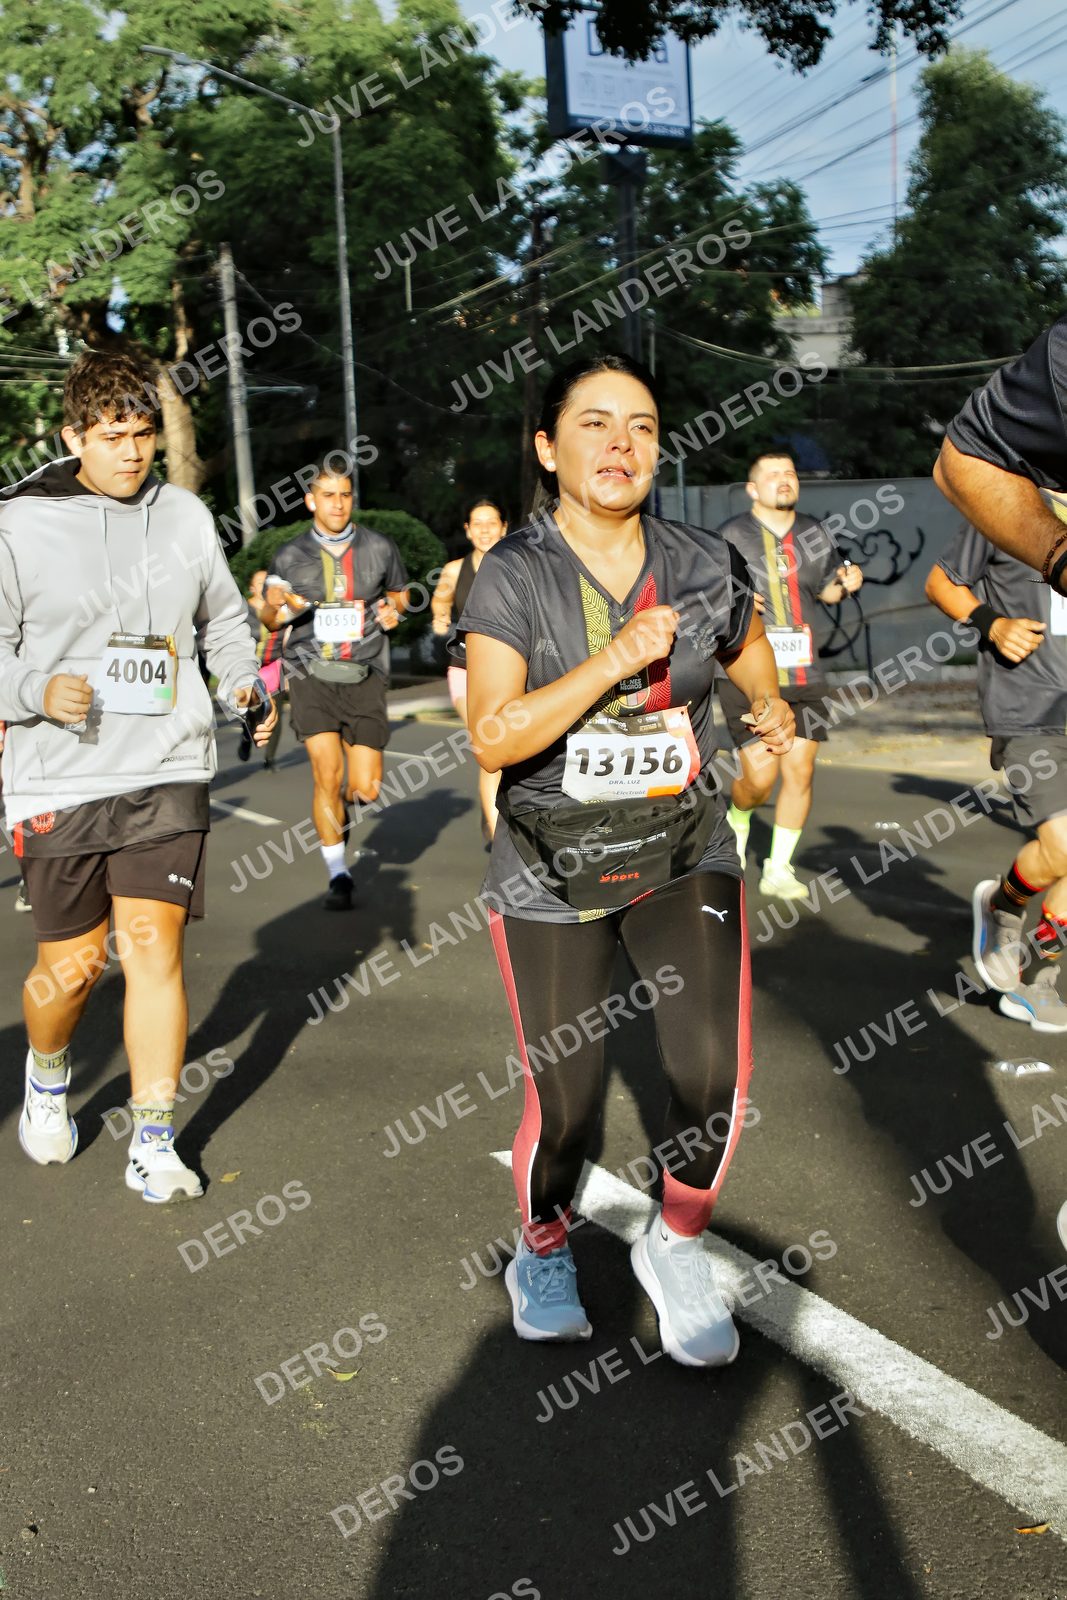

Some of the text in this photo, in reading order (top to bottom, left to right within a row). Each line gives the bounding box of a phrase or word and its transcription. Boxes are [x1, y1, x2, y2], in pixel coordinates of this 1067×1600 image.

[316, 614, 357, 626] 10550
[106, 658, 167, 684] 4004
[575, 744, 683, 777] 13156
